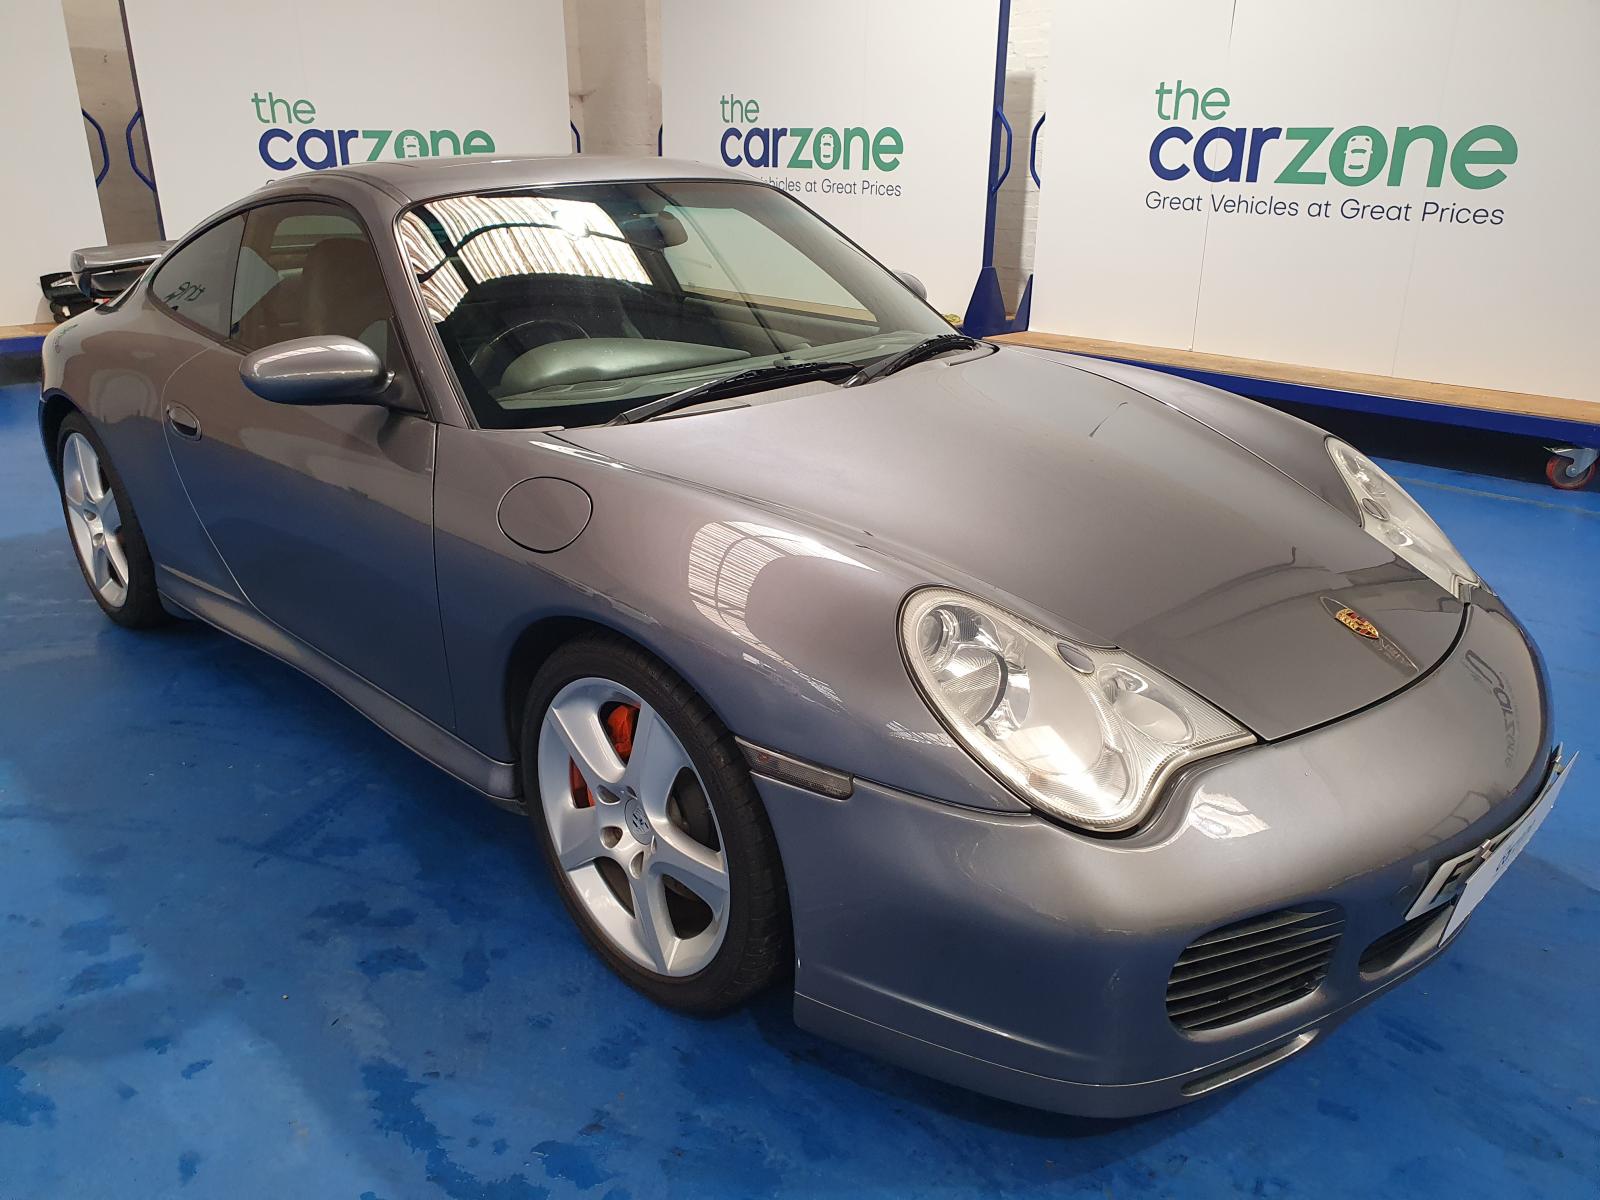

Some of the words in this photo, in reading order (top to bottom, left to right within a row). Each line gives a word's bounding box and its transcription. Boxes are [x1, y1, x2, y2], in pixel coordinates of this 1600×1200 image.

[251, 92, 316, 124] the
[720, 93, 760, 123] the
[1155, 80, 1230, 121] the
[720, 127, 904, 172] carzone
[1149, 125, 1519, 190] carzone
[805, 180, 817, 193] at
[821, 179, 857, 195] Great
[862, 180, 902, 197] Prices
[1145, 191, 1203, 212] Great
[1211, 194, 1299, 216] Vehicles
[1307, 200, 1331, 218] at
[1340, 199, 1412, 222] Great
[1421, 202, 1505, 225] Prices
